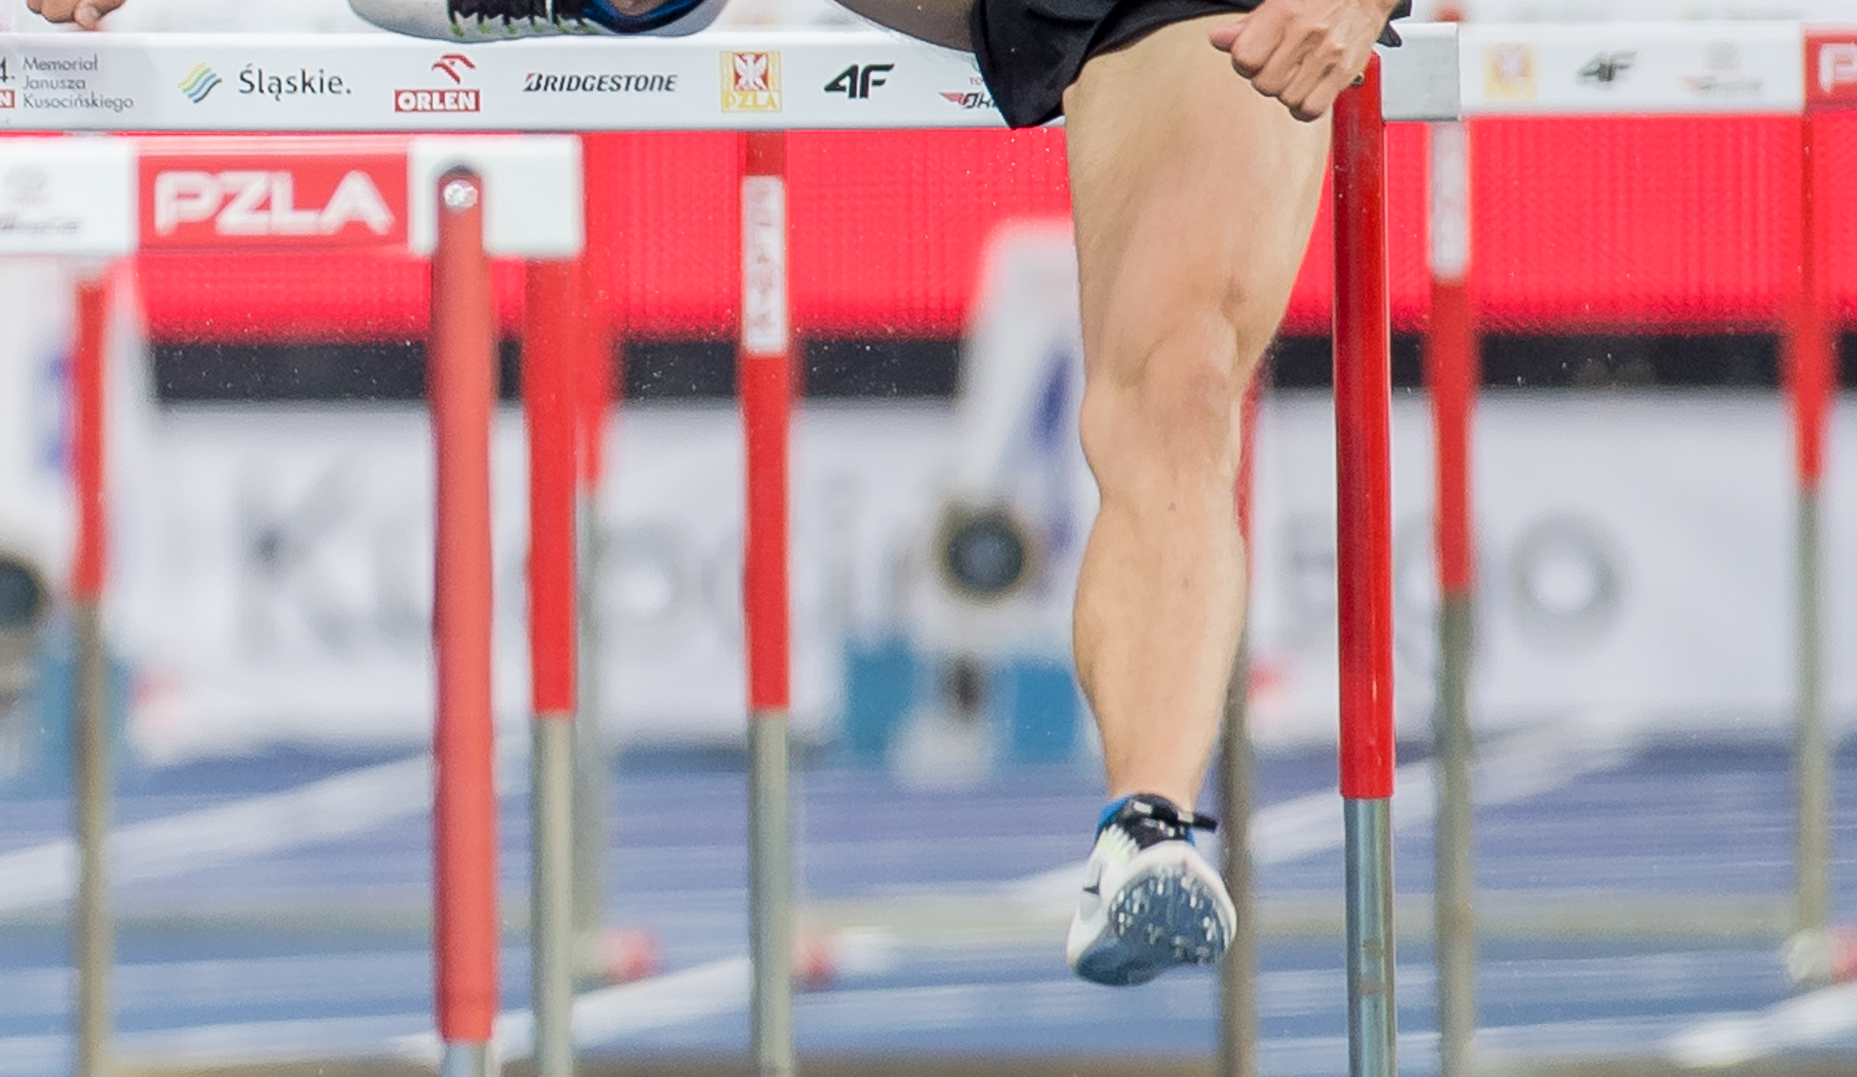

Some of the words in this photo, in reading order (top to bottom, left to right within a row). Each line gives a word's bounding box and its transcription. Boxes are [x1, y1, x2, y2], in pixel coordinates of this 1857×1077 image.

[22, 54, 99, 72] Memoriał
[22, 75, 87, 91] Janusza
[238, 63, 353, 101] Śląskie.
[523, 73, 678, 93] BRIDGESTONE
[824, 63, 895, 99] 4F
[396, 90, 480, 112] ORLEN
[153, 168, 396, 236] PZLA
